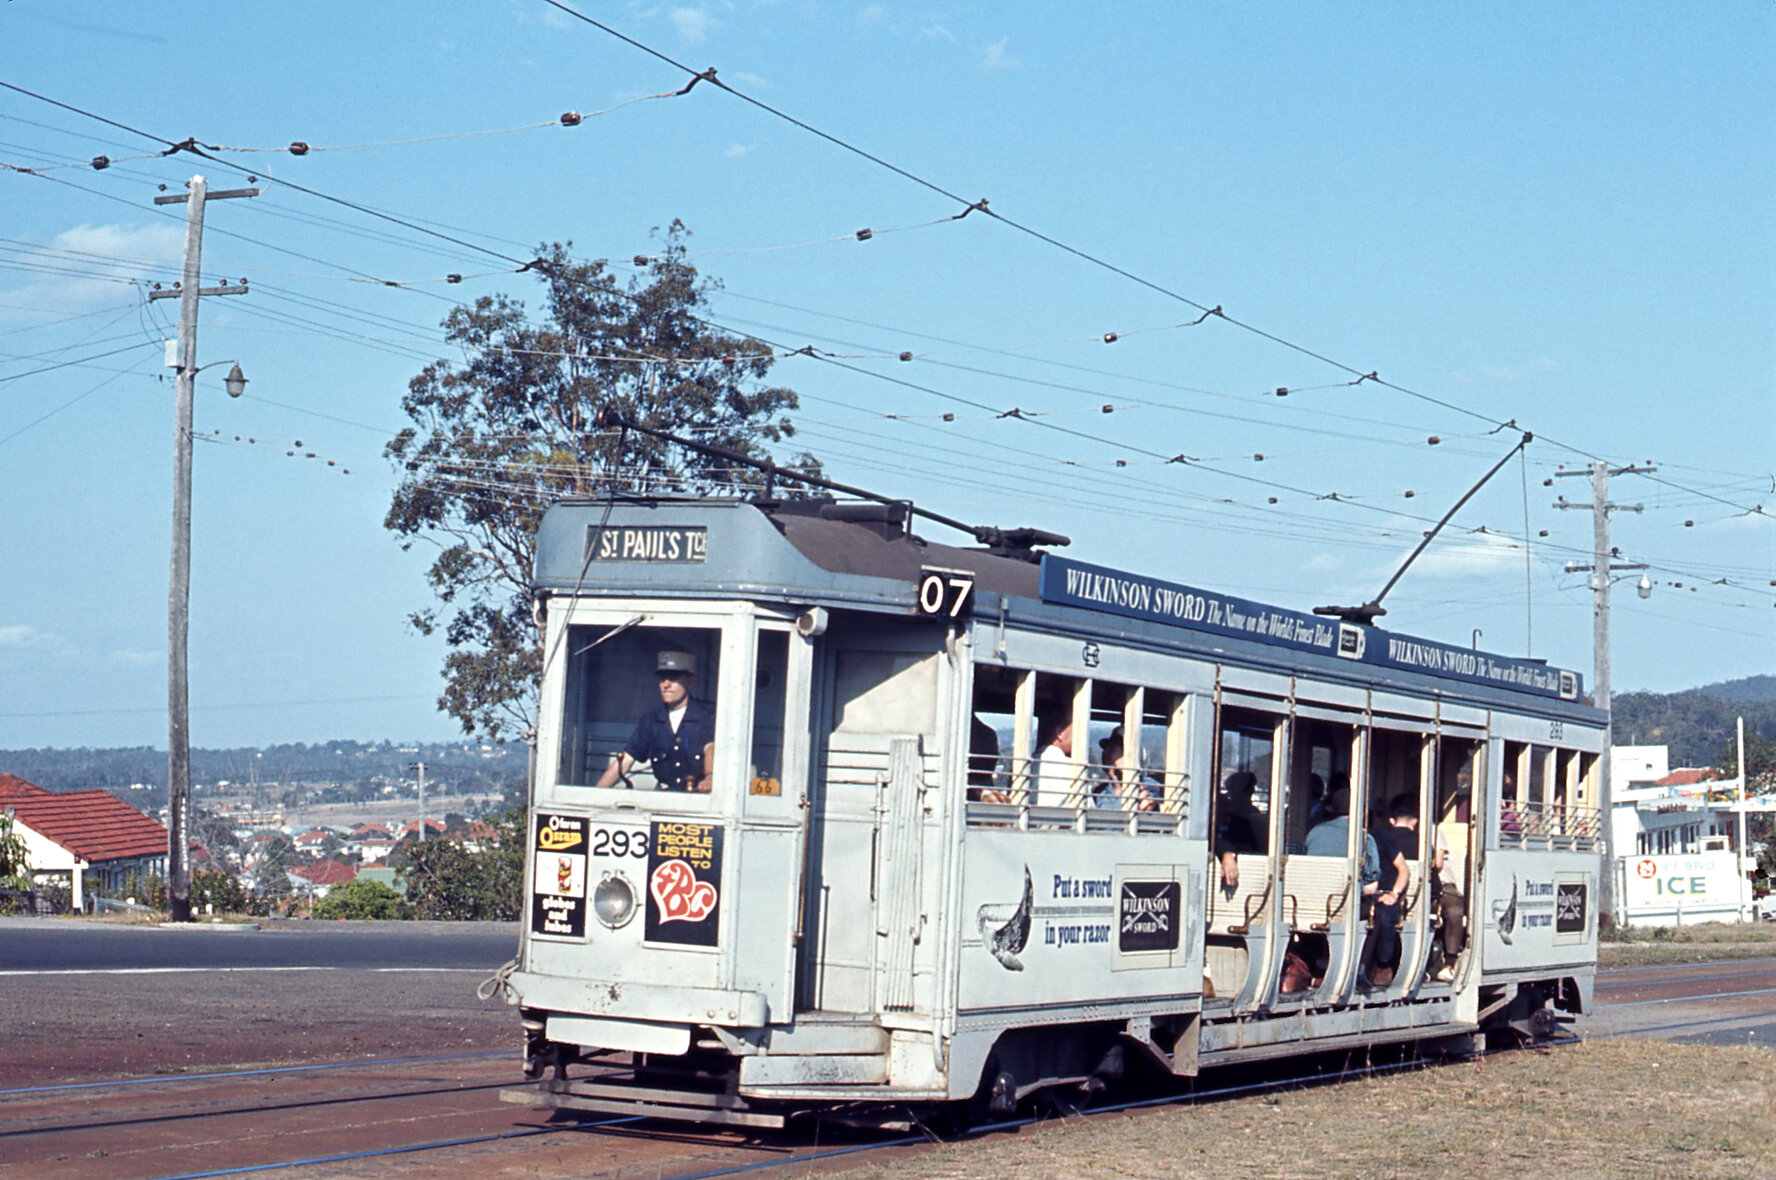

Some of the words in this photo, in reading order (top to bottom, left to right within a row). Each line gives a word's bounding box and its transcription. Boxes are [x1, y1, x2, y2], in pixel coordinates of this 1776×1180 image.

[622, 530, 680, 559] PAUL'S
[920, 575, 973, 617] 07
[1066, 568, 1152, 611] WILKINSON
[1153, 588, 1206, 621] SWORD
[1206, 600, 1223, 625] The
[1389, 639, 1443, 669] WILKINSON
[1443, 650, 1476, 675] SWORD
[658, 824, 714, 836] MOST
[593, 828, 649, 859] 293
[658, 834, 713, 848] PEOPLE
[657, 846, 712, 859] LISTEN
[691, 860, 712, 870] TO
[1053, 874, 1072, 898] Put
[1074, 880, 1080, 898] a
[1082, 875, 1112, 898] sword
[1657, 876, 1706, 896] ICE
[548, 909, 568, 921] and
[1122, 898, 1170, 913] WILKINSON
[1045, 920, 1056, 944] in
[1058, 925, 1082, 948] your
[1083, 925, 1111, 944] razor
[1134, 922, 1156, 933] SWORD
